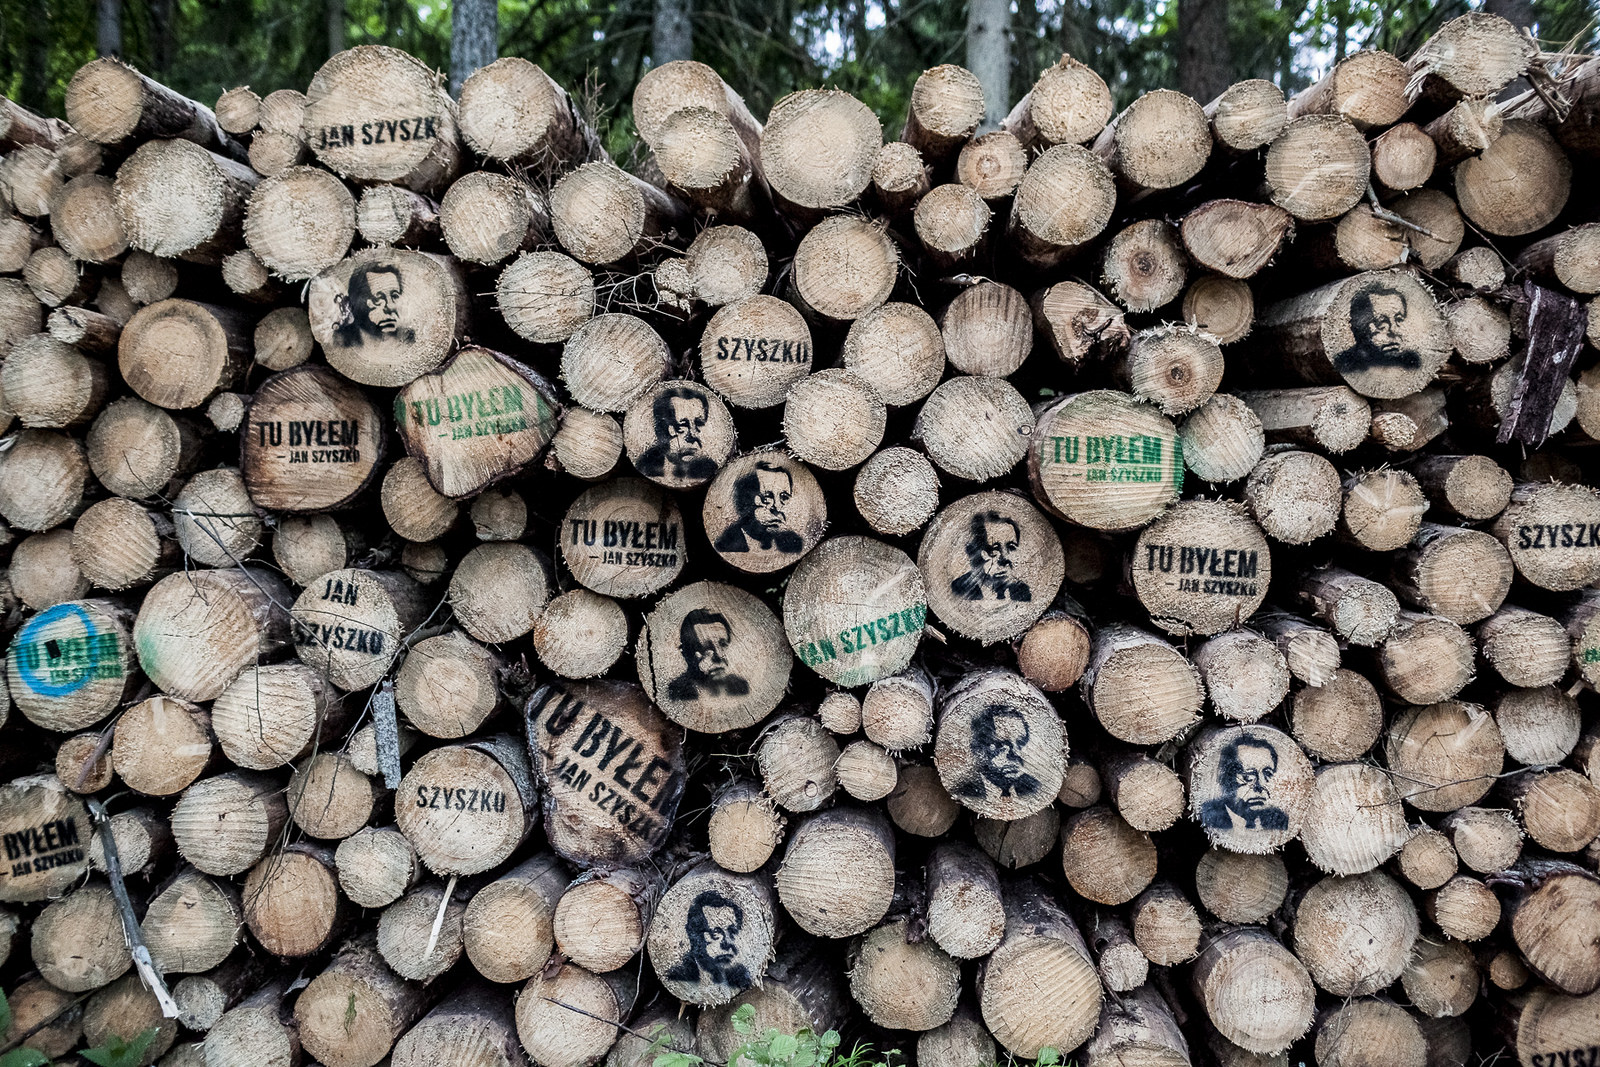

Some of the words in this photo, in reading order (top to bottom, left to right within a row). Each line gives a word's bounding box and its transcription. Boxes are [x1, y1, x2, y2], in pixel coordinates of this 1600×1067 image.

[319, 125, 355, 150] JAN
[409, 397, 440, 428] TU
[257, 421, 282, 447] TU
[288, 419, 359, 447] BYŁEM
[289, 449, 308, 463] JAN
[312, 448, 360, 464] SZYSZKO
[1050, 436, 1079, 464] TU
[1086, 434, 1162, 464] BYŁEM
[570, 519, 596, 546] TU
[603, 520, 677, 549] BYŁEM
[602, 551, 623, 565] JAN
[625, 551, 677, 567] SZYSZKO
[1146, 545, 1173, 572] TU
[1180, 546, 1258, 578] BYŁEM
[322, 578, 360, 606] JAN
[1177, 578, 1200, 592] JAN
[1202, 579, 1257, 597] SZYSZKO
[416, 784, 506, 813] SZYSZKO
[555, 757, 597, 793] JAN
[588, 781, 670, 848] SZYSZK
[4, 817, 79, 860] BYŁEM
[12, 861, 32, 878] JAN
[34, 848, 84, 873] SZYSZKO
